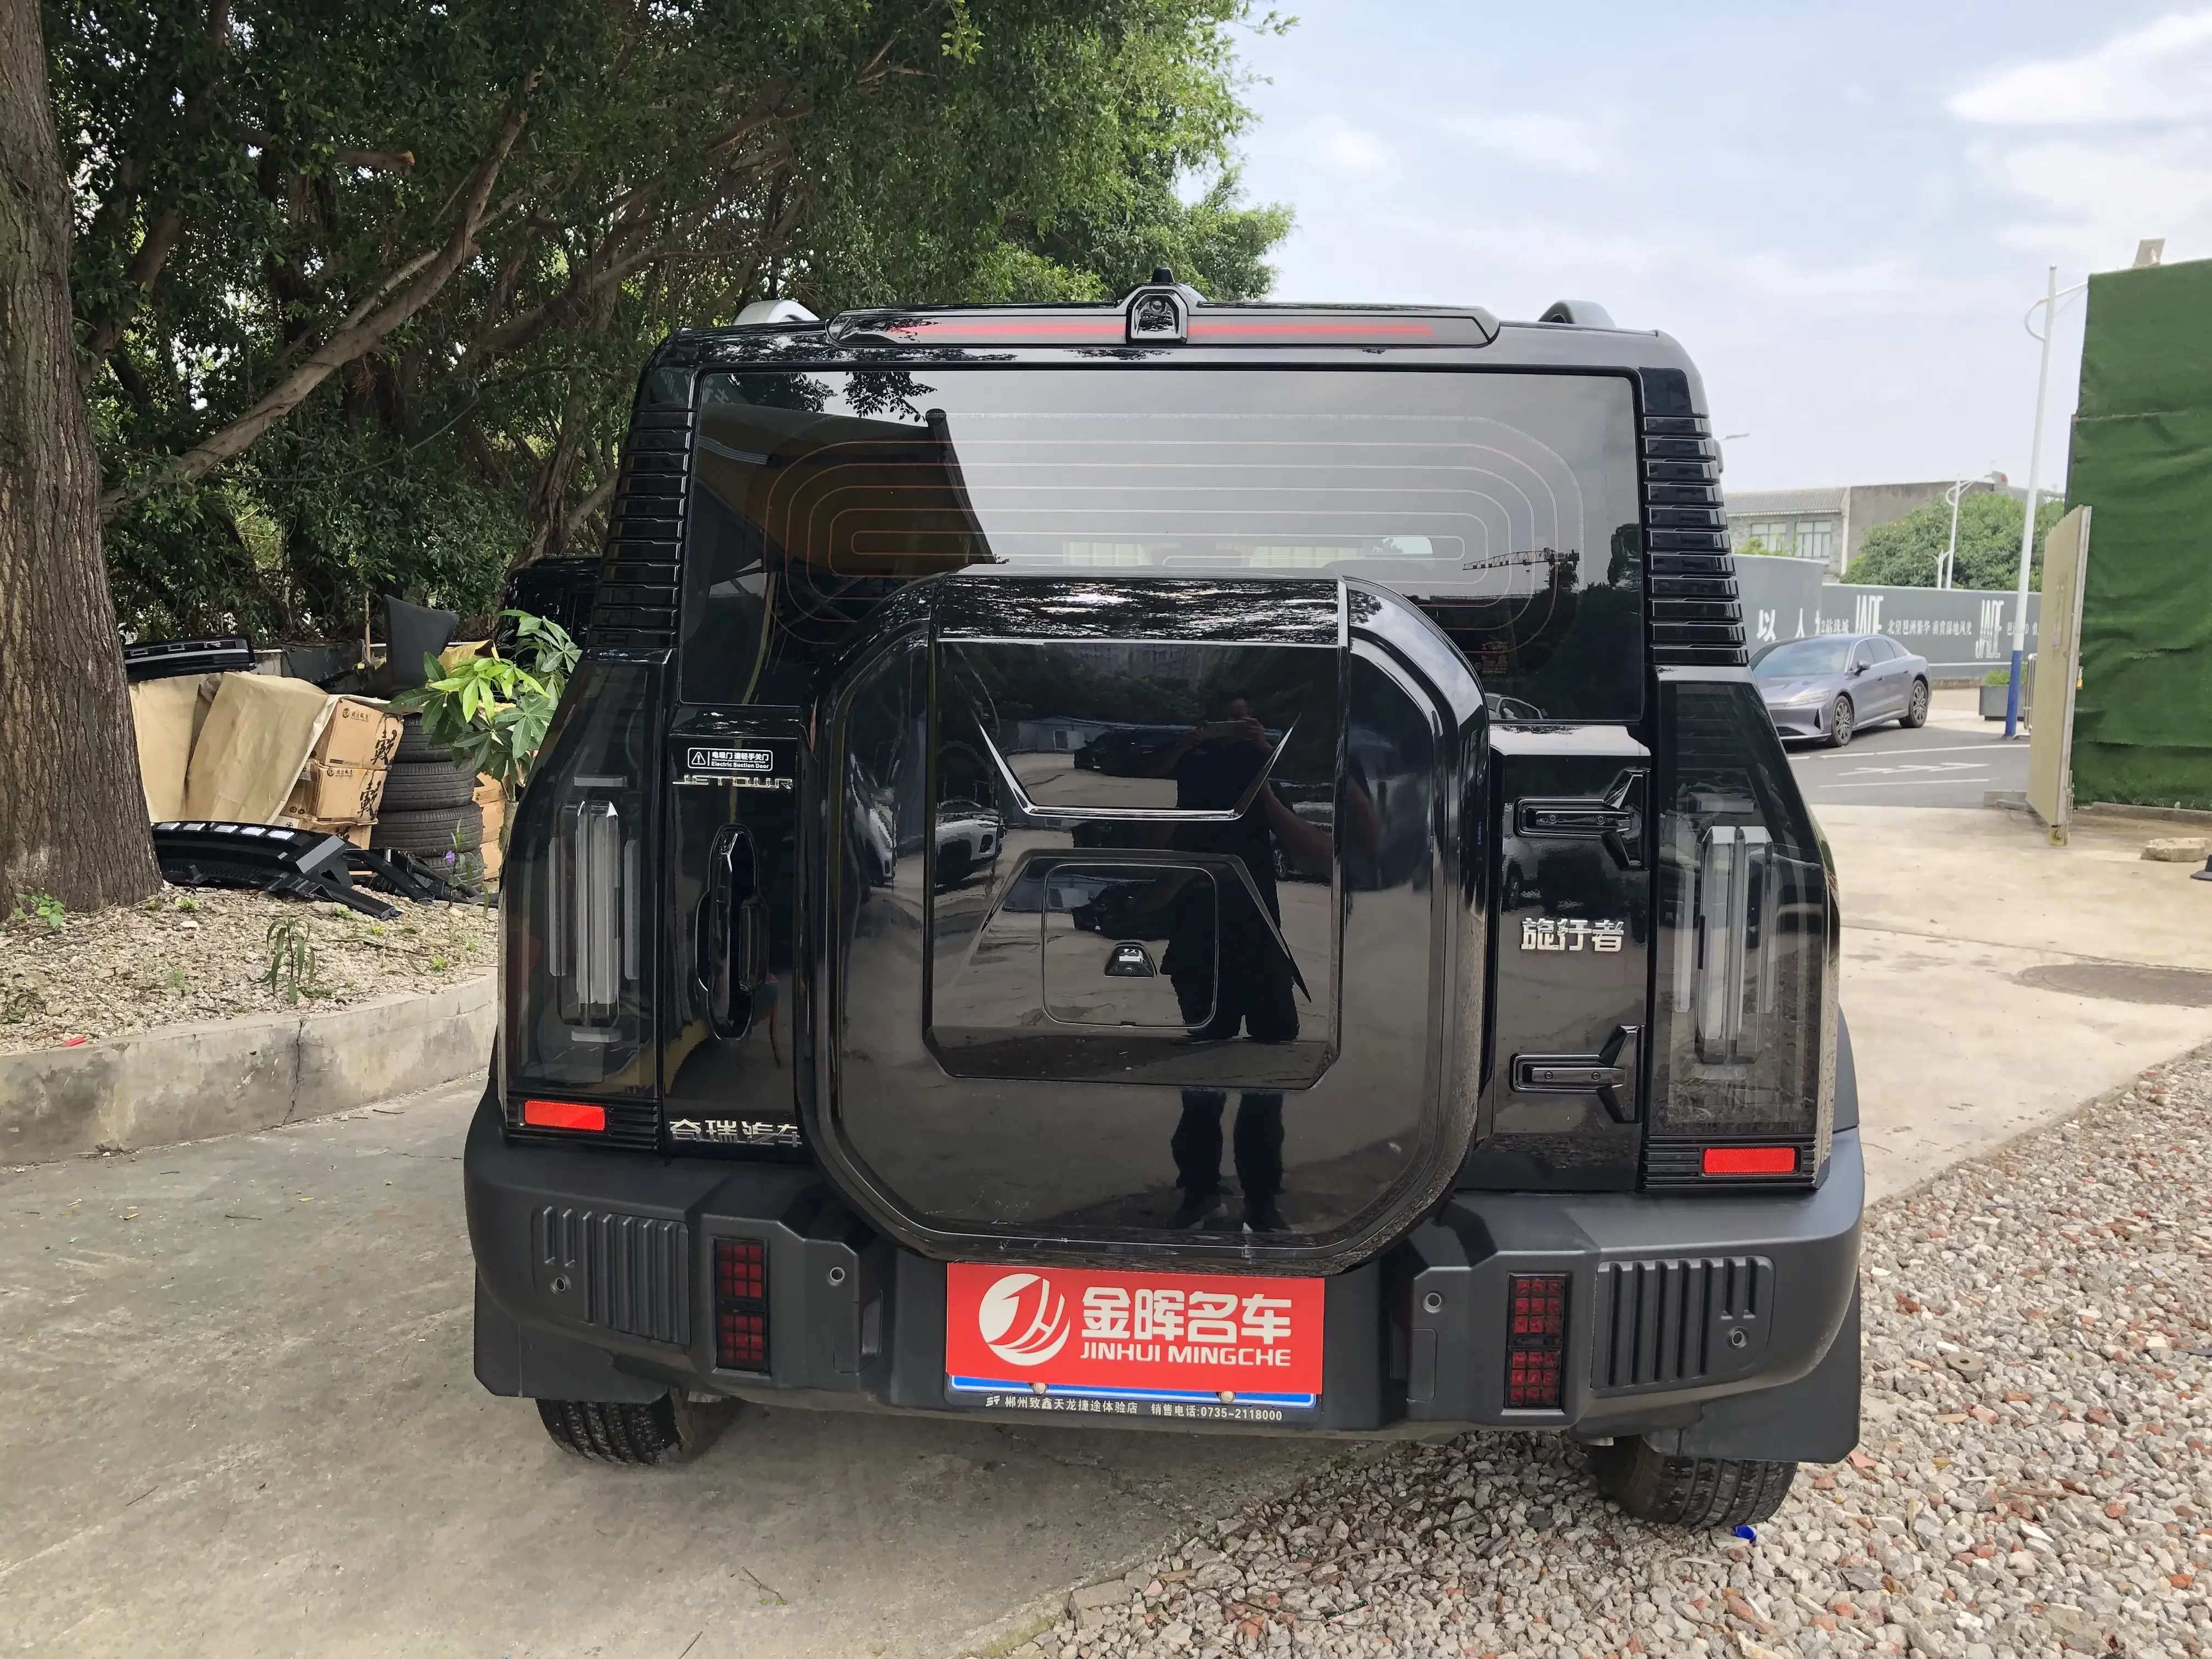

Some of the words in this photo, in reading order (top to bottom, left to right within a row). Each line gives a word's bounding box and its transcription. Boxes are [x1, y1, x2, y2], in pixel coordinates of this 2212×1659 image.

[712, 751, 733, 759] 电吸门
[734, 752, 769, 761] 请轻手关门
[673, 774, 793, 789] JETOUR
[1520, 917, 1624, 952] 旅行者
[669, 1118, 803, 1148] 奇瑞汽车
[1081, 1286, 1292, 1345] 金晖名车
[1080, 1341, 1160, 1362] JINHUI
[1168, 1345, 1291, 1366] MINGCHE
[1005, 1395, 1138, 1414] 郴州致鑫天龙捷途体验店
[1150, 1402, 1283, 1421] 销售电话:0735-2118000
